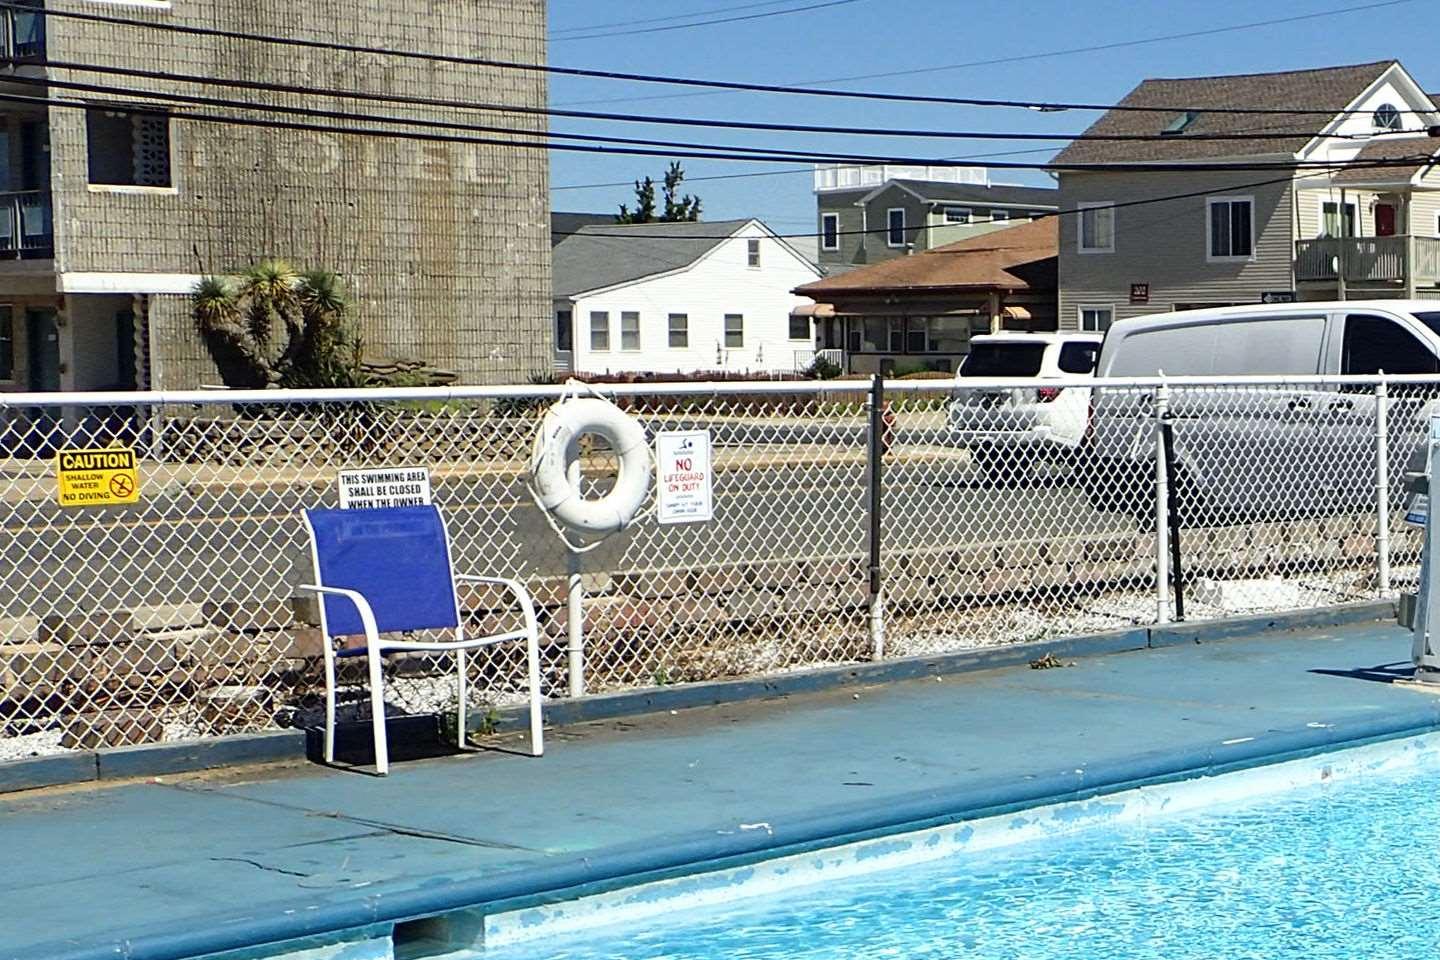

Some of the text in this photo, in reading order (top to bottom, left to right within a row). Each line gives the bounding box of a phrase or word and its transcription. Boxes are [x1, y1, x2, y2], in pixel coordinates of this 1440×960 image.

[63, 453, 130, 469] CAUTION
[675, 457, 693, 472] NO
[66, 473, 104, 482] SHALLOW
[341, 471, 426, 485] THIS SWIMMING AREA
[663, 472, 704, 483] LIFEGUARD
[348, 484, 421, 497] SHALL BE CLOSED
[668, 482, 700, 493] ON DUTY
[63, 491, 111, 501] NO DIVING
[347, 497, 424, 510] WHEN THE OWNER
